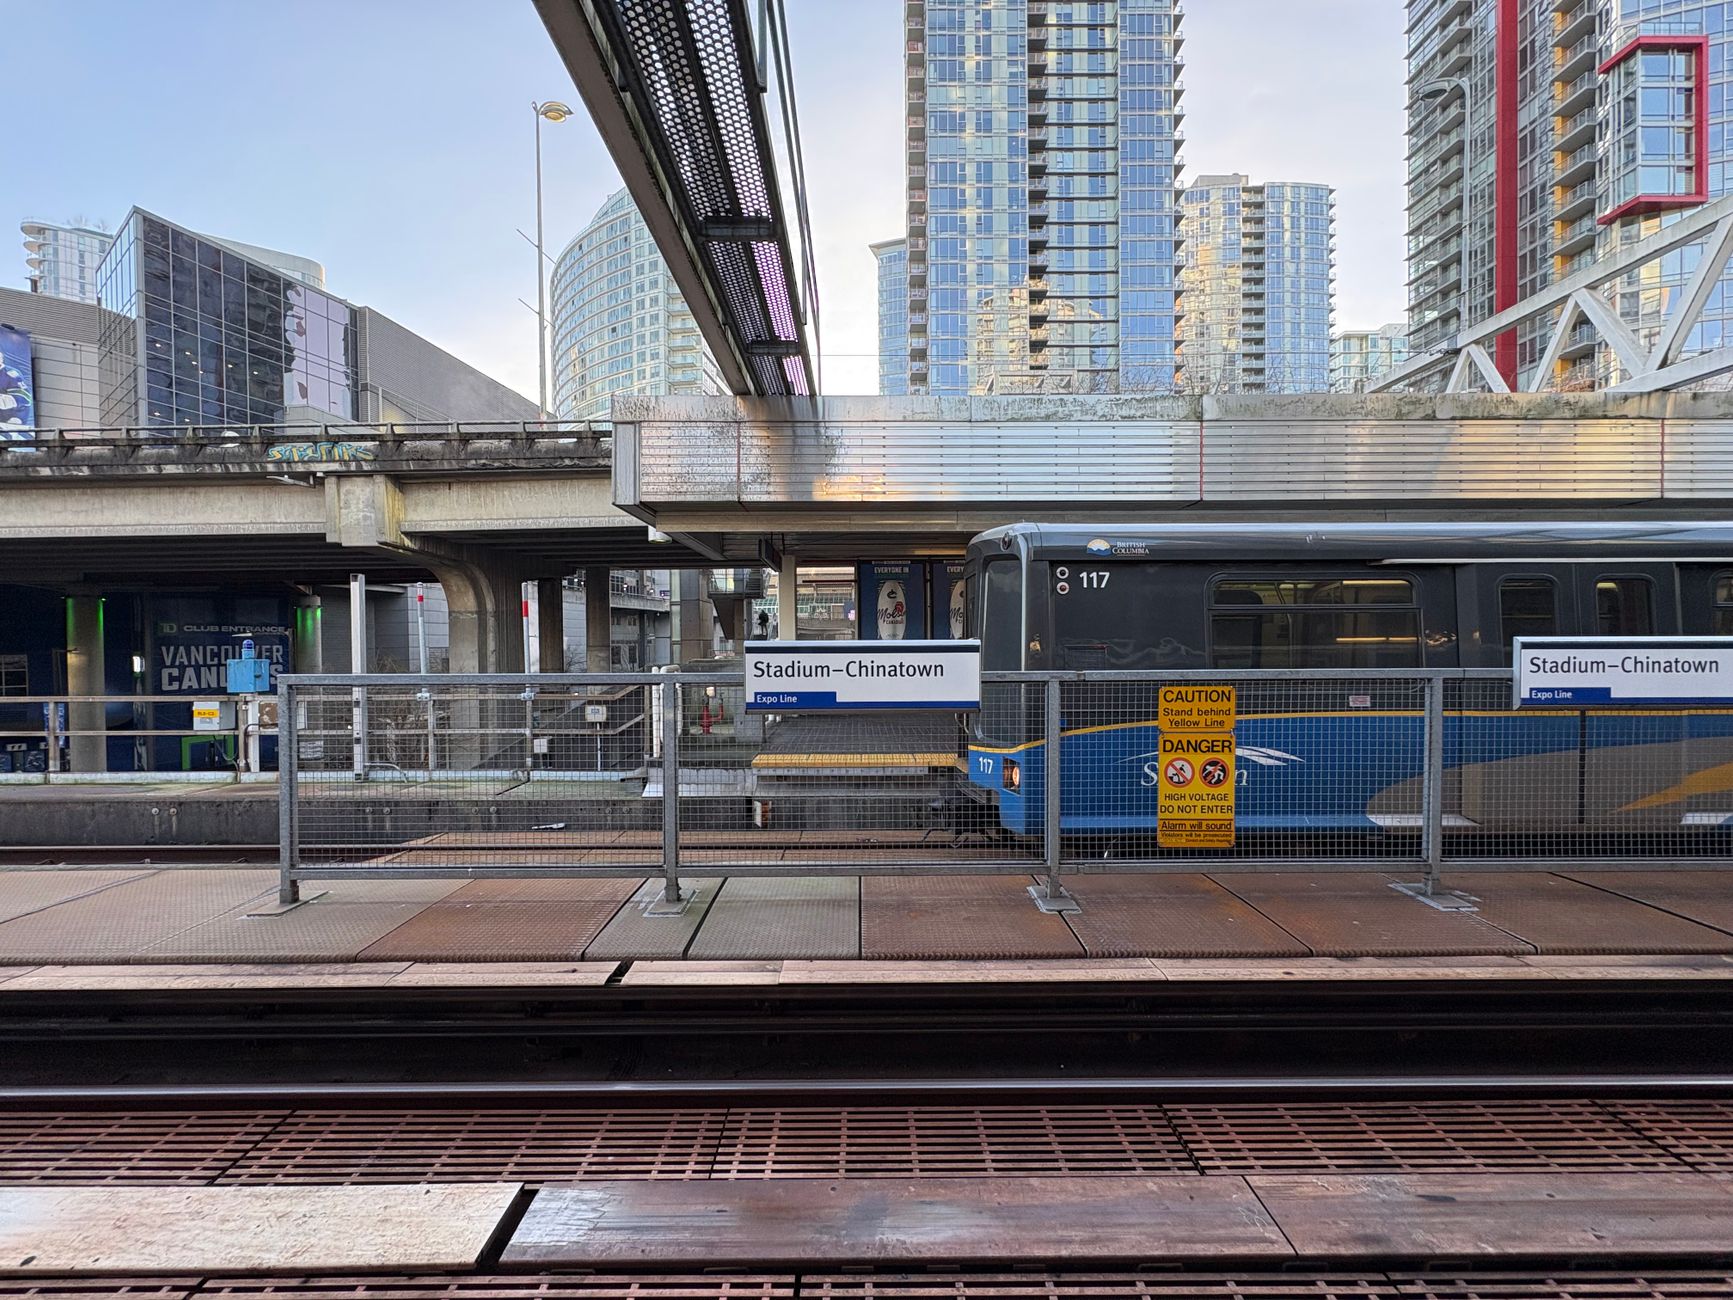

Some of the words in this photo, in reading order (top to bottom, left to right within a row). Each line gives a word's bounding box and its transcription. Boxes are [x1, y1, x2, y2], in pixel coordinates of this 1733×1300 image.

[1079, 571, 1110, 589] 117
[877, 607, 907, 624] Mols
[221, 625, 285, 633] ENTRANCE
[161, 664, 284, 691] CANS
[756, 694, 778, 705] Expo
[780, 694, 798, 703] Line
[1163, 690, 1231, 703] CAUTION
[1531, 690, 1553, 700] Expo
[1554, 690, 1573, 699] Line
[1163, 707, 1193, 717] Stand
[1197, 707, 1231, 717] behind
[1169, 718, 1200, 727] Yellow
[1205, 718, 1225, 727] Line
[1162, 739, 1232, 753] DANGER
[979, 756, 993, 774] 117
[1164, 793, 1186, 801] HIGH
[1189, 793, 1229, 801] VOLTAGE
[1160, 805, 1174, 813] DO
[1177, 805, 1197, 813] NOT
[1200, 805, 1233, 814] ENTER
[1161, 821, 1186, 830] Alarm
[1189, 822, 1203, 830] will
[1205, 822, 1232, 830] sound
